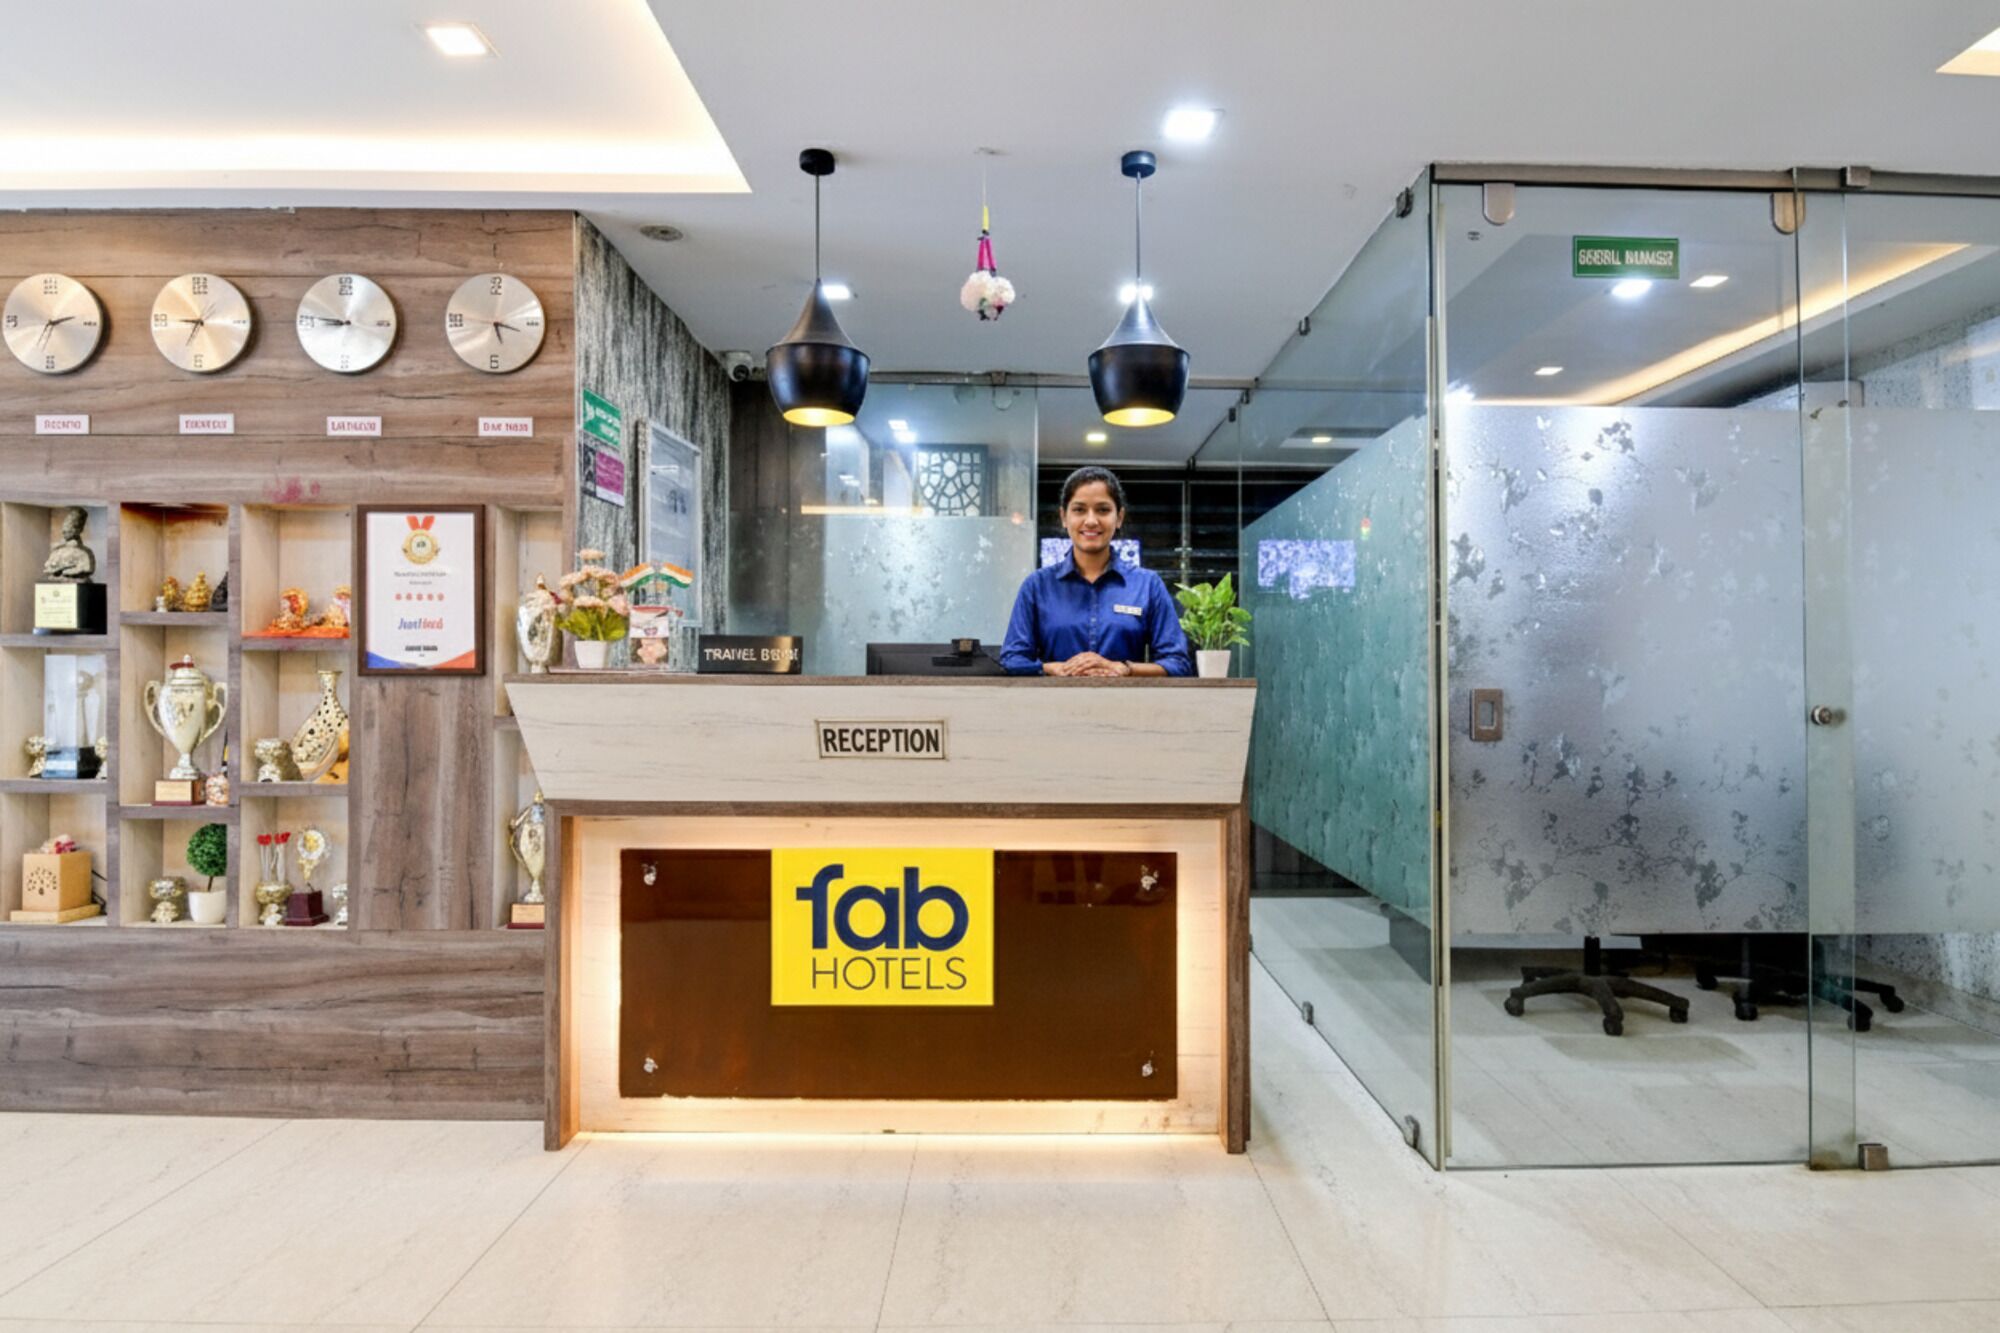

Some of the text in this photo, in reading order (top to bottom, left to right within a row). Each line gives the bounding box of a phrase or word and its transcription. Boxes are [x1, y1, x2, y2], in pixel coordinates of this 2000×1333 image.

[823, 728, 939, 753] RECEPTION
[796, 864, 969, 951] fab
[812, 956, 967, 991] HOTELS
